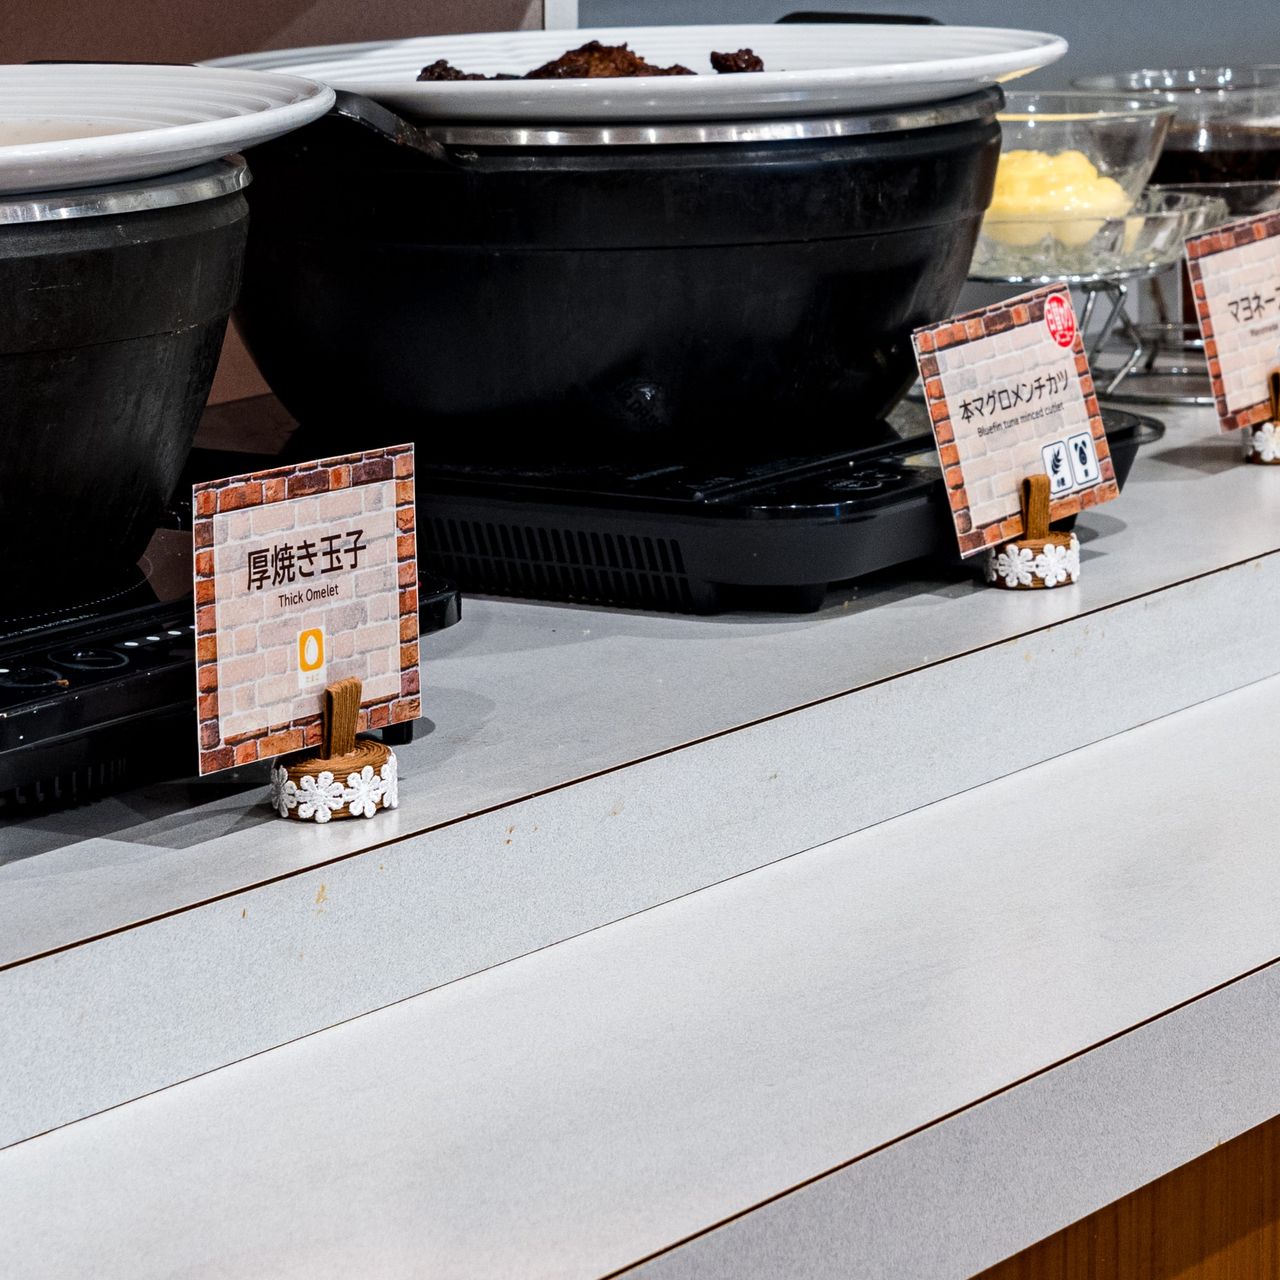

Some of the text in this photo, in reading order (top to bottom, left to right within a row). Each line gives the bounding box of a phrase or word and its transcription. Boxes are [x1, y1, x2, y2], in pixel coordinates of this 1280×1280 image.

[959, 369, 1068, 424] 本マグロメンチカツ
[977, 421, 1002, 437] Bluefin
[1020, 408, 1044, 423] minced
[247, 529, 367, 591] 厚焼き玉子
[278, 584, 339, 608] Thick Omelet
